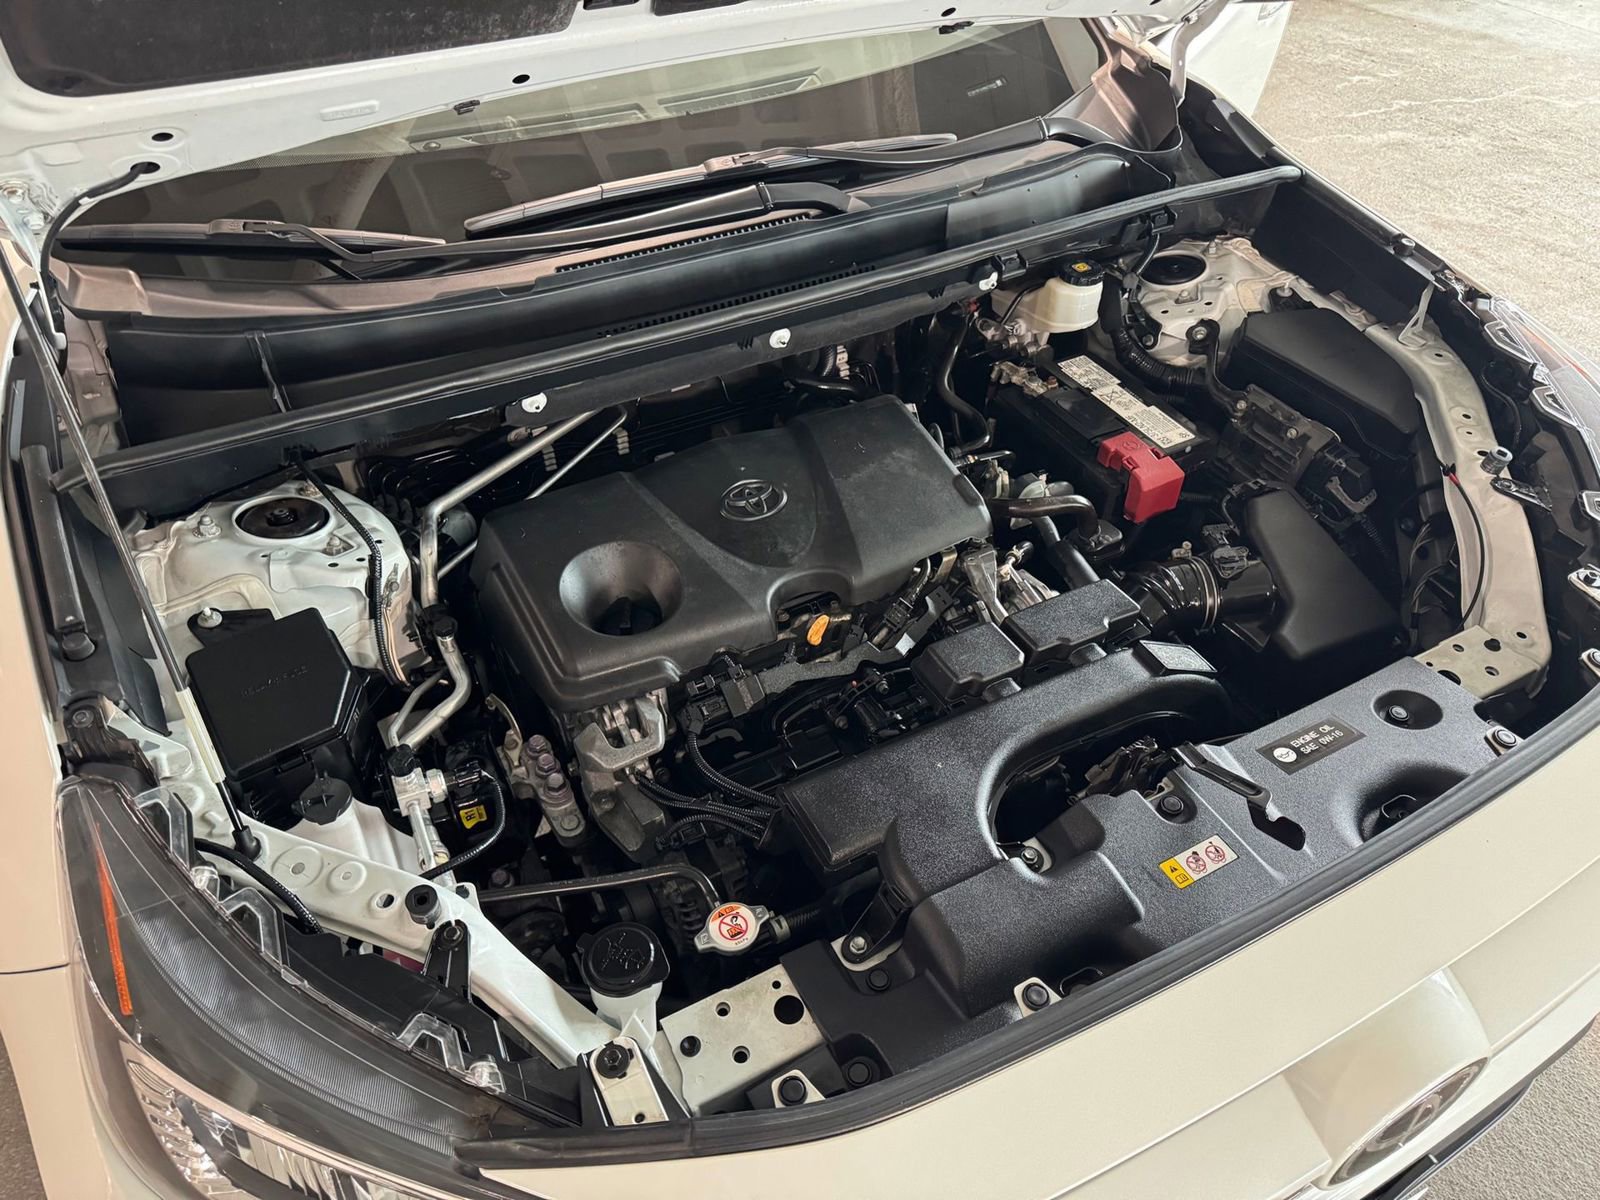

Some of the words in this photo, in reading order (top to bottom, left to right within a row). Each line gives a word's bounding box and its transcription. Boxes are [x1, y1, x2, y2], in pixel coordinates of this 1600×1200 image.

[1290, 731, 1320, 748] ENGINE
[1319, 724, 1335, 733] OIL
[1300, 742, 1319, 754] SAE
[1319, 729, 1344, 745] 0W-16
